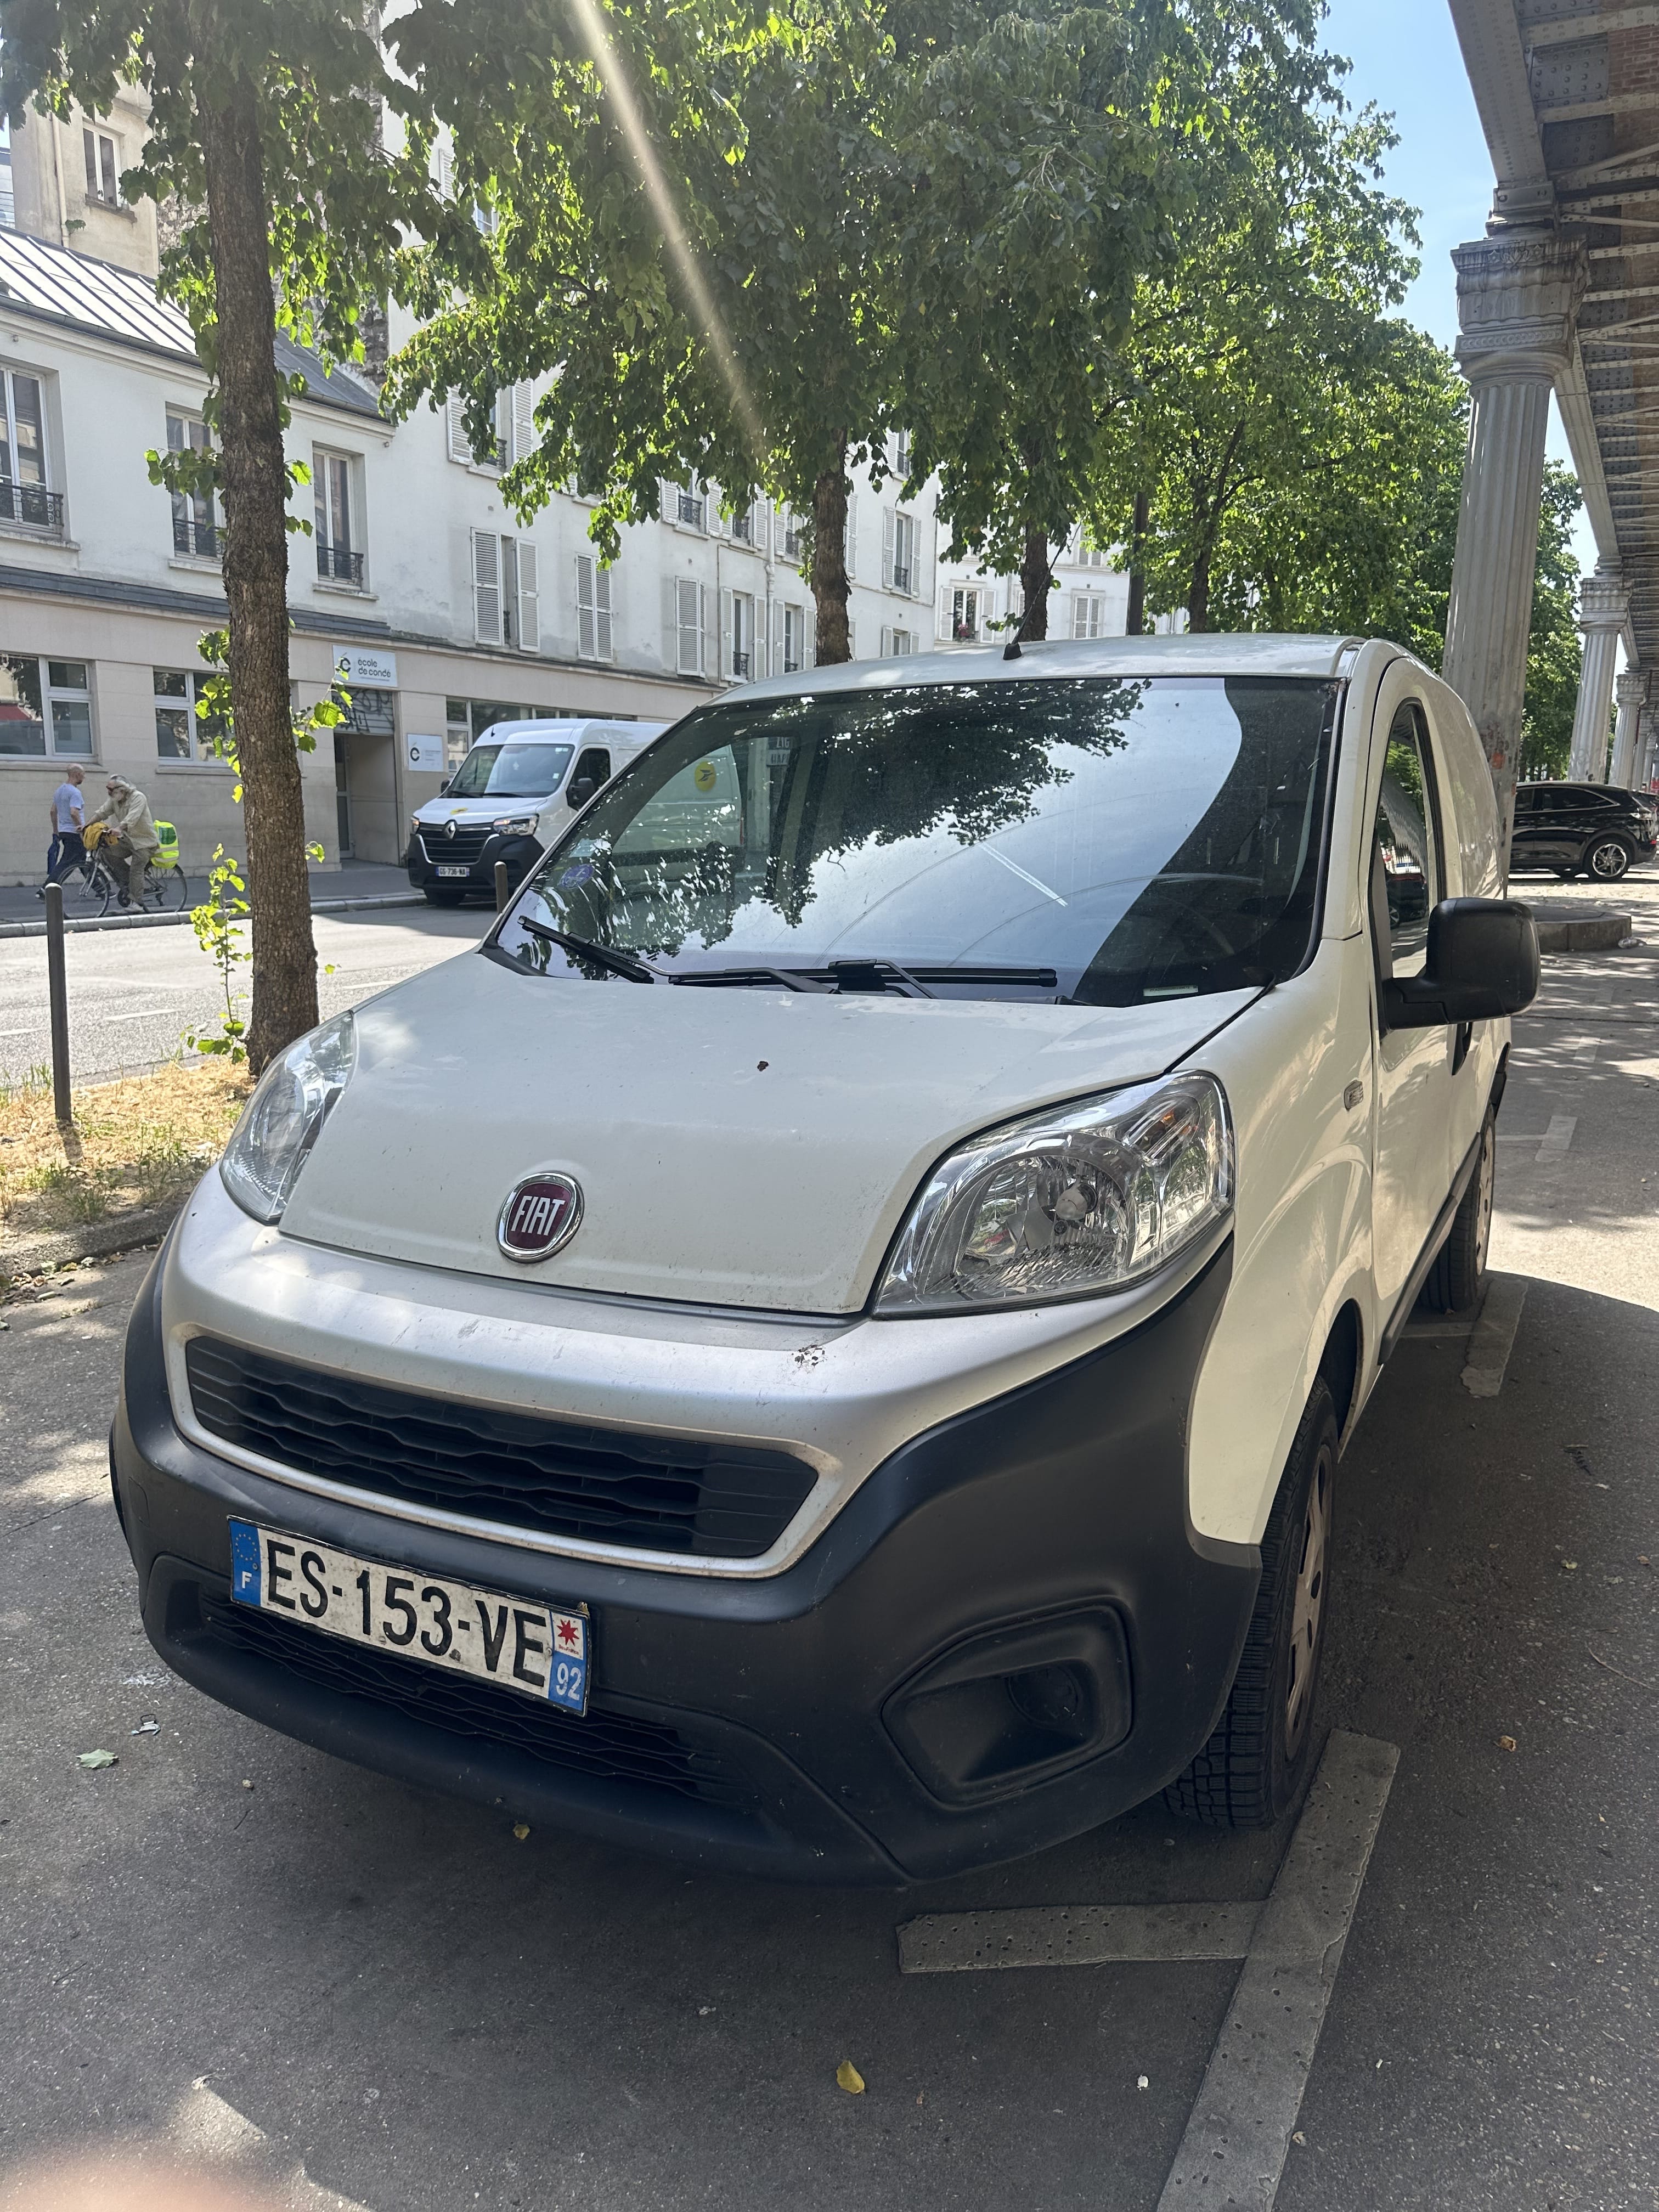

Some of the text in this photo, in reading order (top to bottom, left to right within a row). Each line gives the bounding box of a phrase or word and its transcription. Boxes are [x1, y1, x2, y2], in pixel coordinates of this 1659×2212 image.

[358, 657, 377, 667] école
[358, 666, 391, 678] de condé
[511, 1195, 566, 1236] FIAT
[242, 1571, 252, 1589] F
[267, 1539, 546, 1688] ES-153-VE
[556, 1662, 582, 1701] 92
